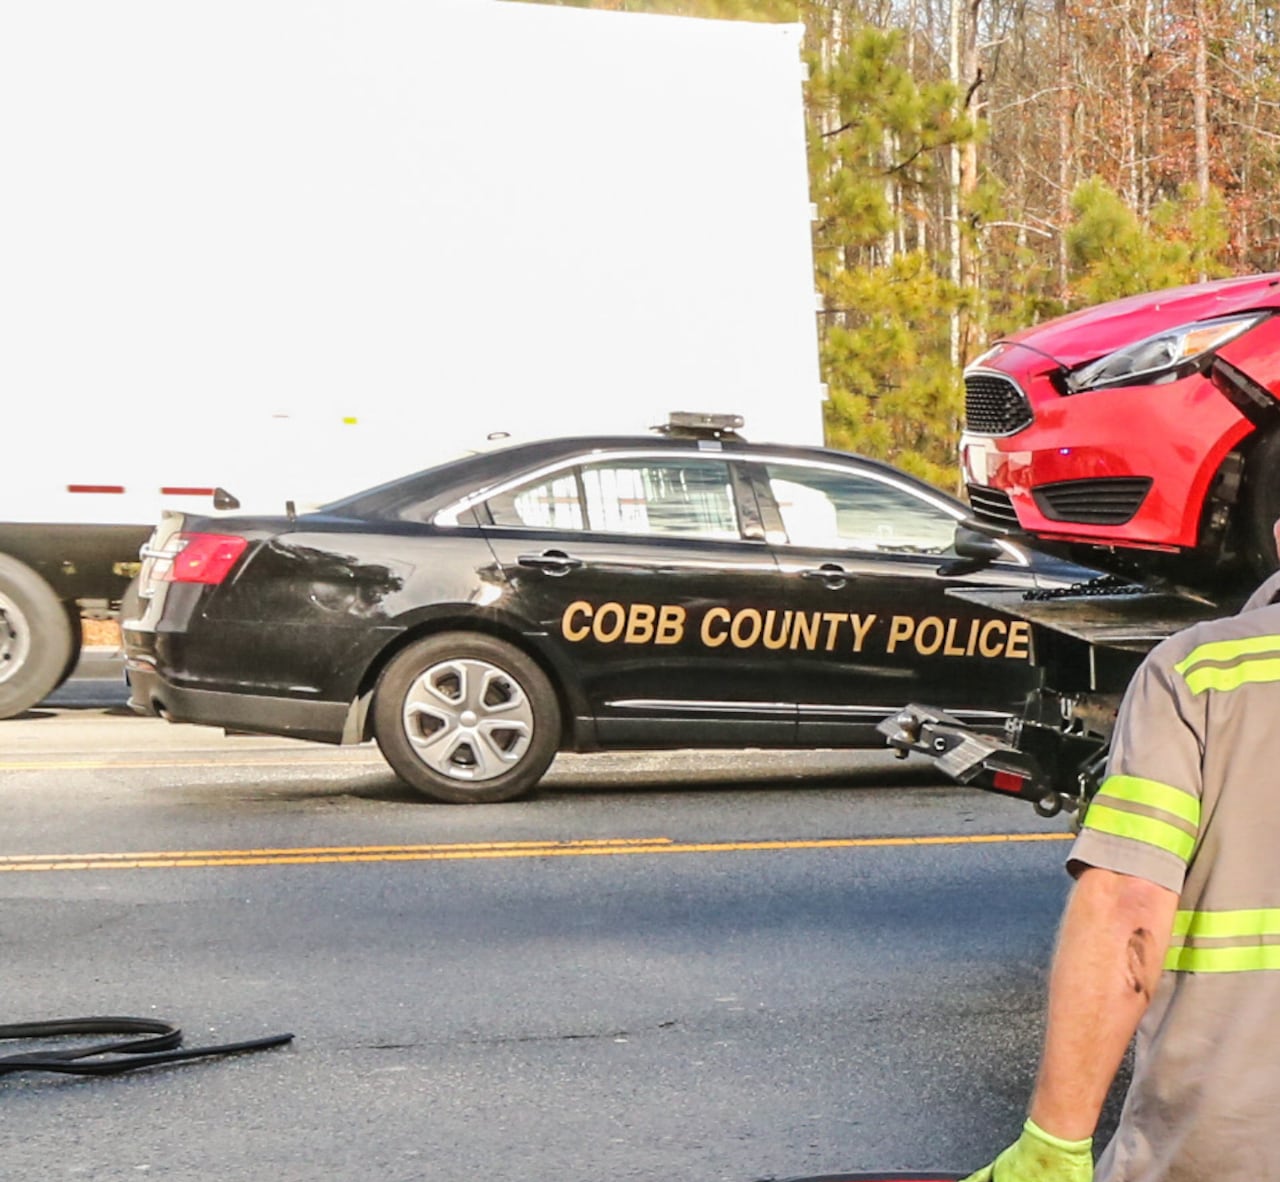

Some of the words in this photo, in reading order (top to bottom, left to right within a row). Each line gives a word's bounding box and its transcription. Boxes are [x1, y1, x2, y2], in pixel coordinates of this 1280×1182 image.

[561, 600, 686, 645] COBB
[700, 607, 876, 652] COUNTY
[886, 615, 1030, 659] POLICE
